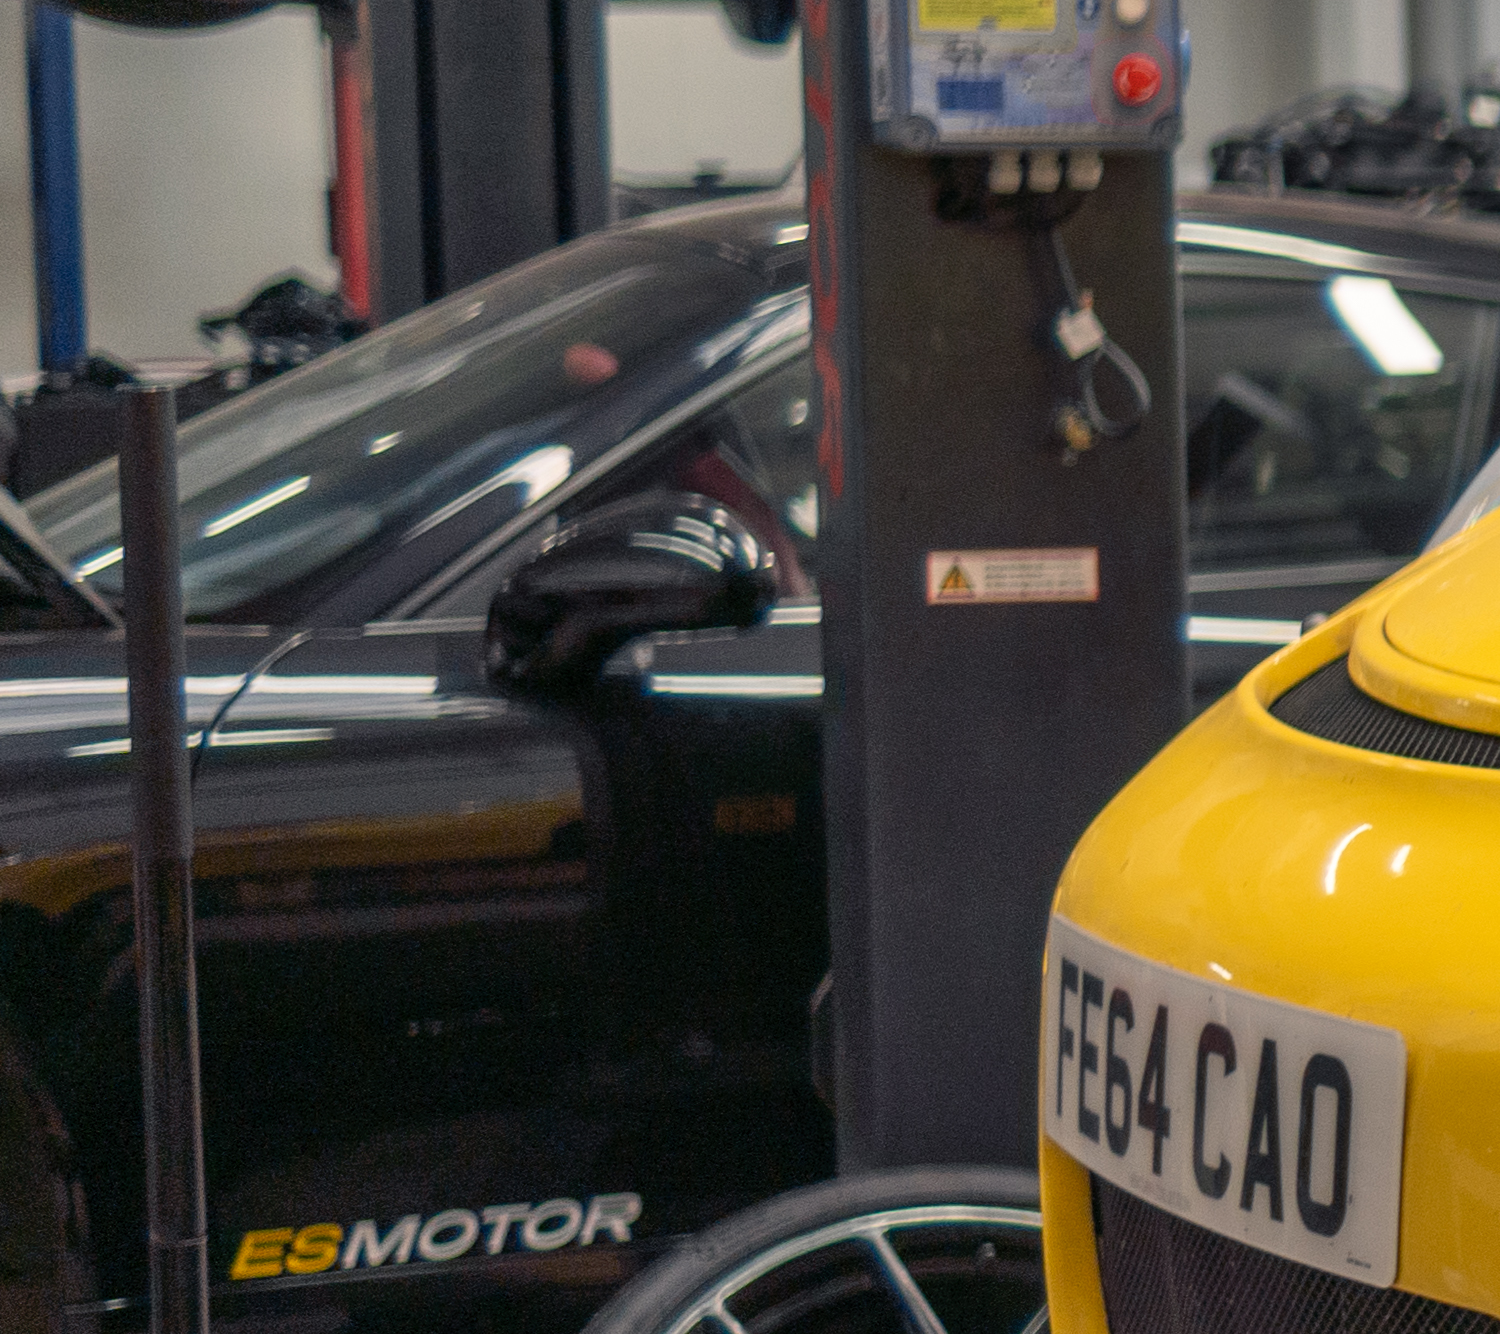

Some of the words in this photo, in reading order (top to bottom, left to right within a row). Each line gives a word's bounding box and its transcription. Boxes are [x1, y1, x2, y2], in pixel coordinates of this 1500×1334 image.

[1056, 956, 1172, 1178] FE64
[1193, 1021, 1354, 1238] CAO
[229, 1191, 643, 1281] ESMOTOR
